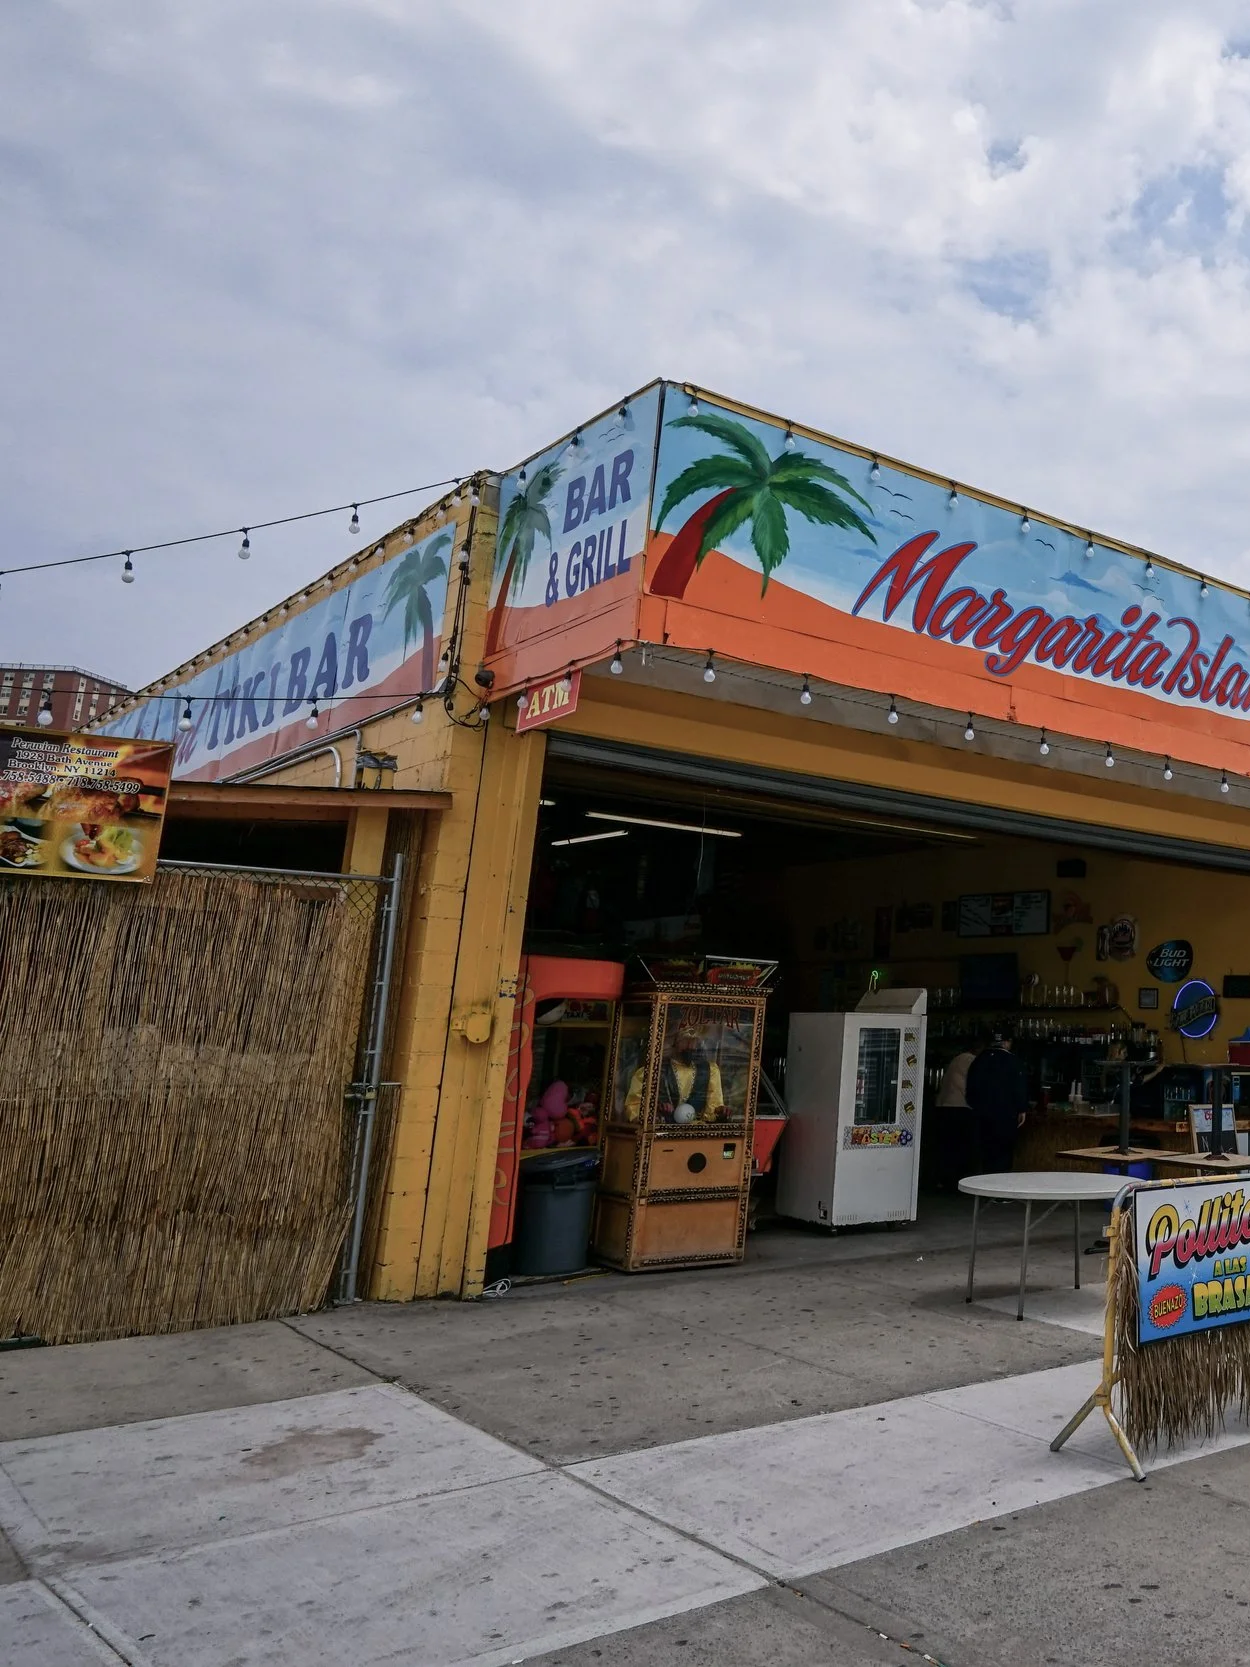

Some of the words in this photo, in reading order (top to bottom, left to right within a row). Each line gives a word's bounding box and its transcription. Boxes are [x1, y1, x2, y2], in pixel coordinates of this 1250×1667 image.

[562, 449, 633, 534] BAR
[545, 551, 560, 607] &
[565, 519, 631, 596] GRILL
[852, 530, 1171, 688] Margarita
[207, 662, 281, 751] TIKI
[282, 613, 373, 718] BAR
[525, 680, 569, 720] ATM
[11, 737, 60, 753] Peruvian
[61, 743, 119, 759] Restaurant
[15, 750, 44, 761] 1928
[45, 754, 72, 765] Bath
[74, 757, 113, 768] Avenue
[63, 765, 80, 774] NY
[84, 767, 117, 778] 11214
[1153, 958, 1189, 967] LIGHT
[1159, 948, 1187, 958] BUD
[678, 1005, 741, 1032] ZOLTAR
[1213, 1259, 1223, 1278] A
[1224, 1255, 1247, 1275] LAS
[1153, 1294, 1184, 1318] BUENAZO
